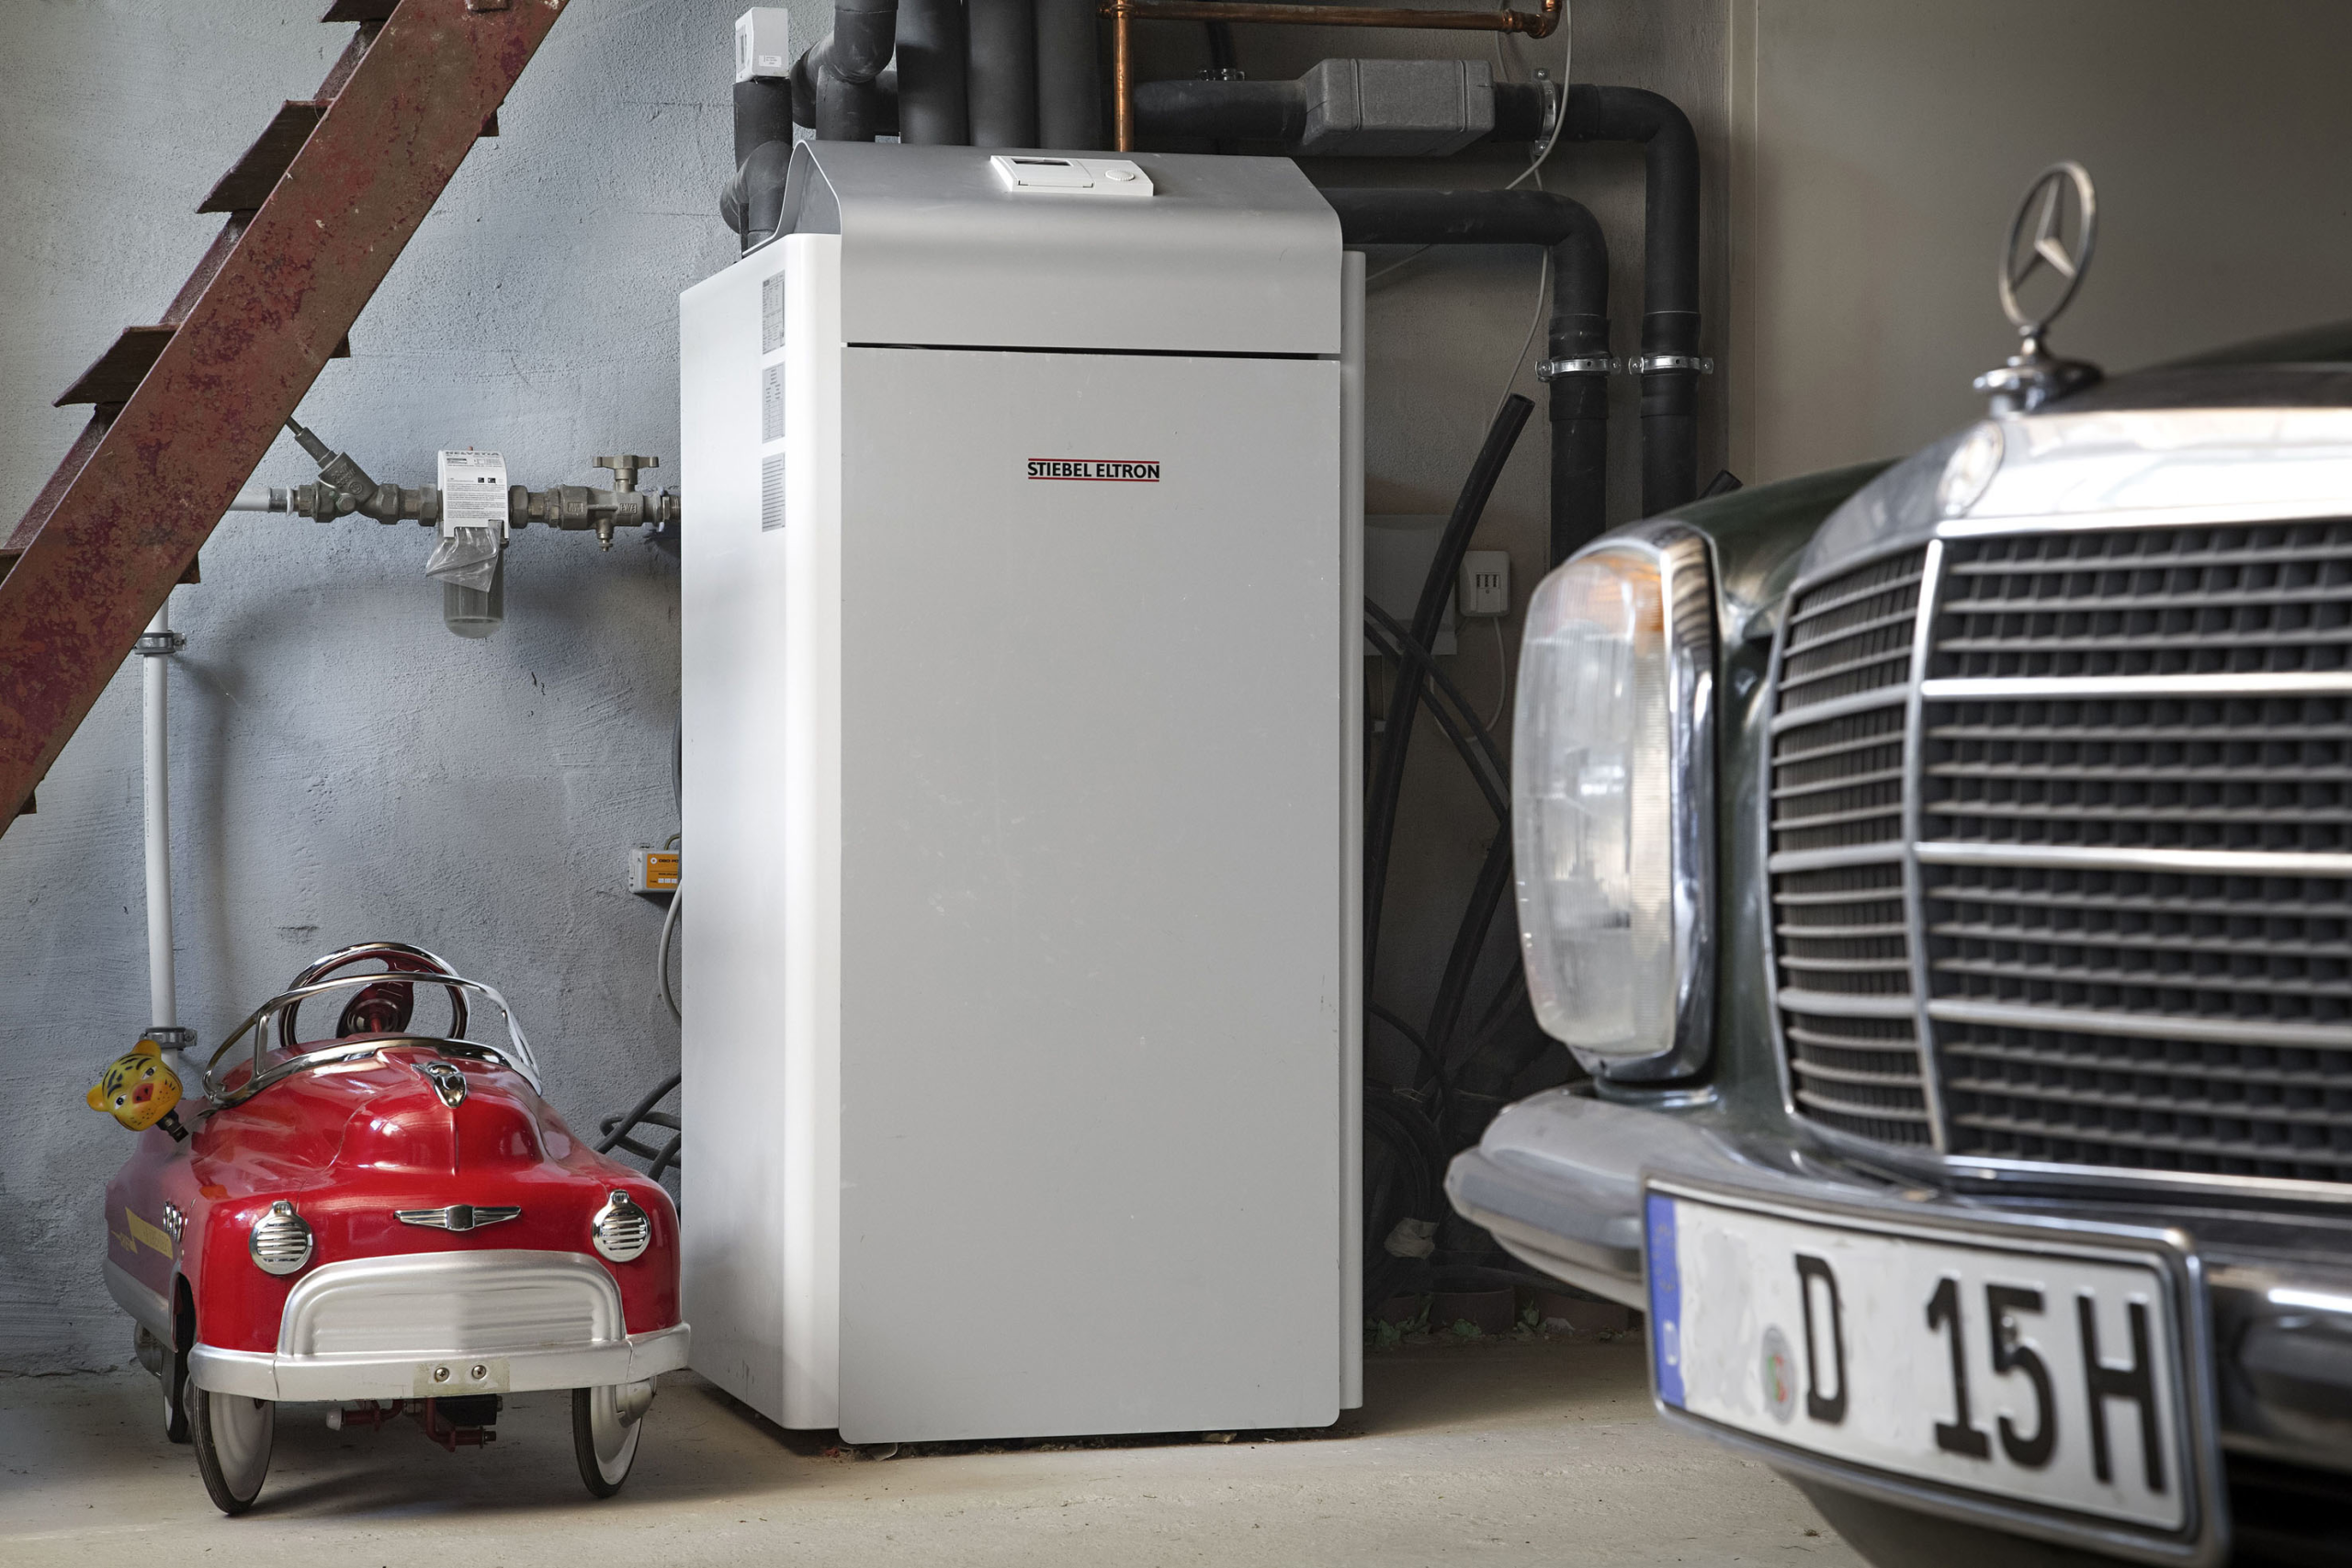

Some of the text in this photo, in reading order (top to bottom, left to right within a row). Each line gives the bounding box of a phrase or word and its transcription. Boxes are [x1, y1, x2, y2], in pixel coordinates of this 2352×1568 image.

[1027, 461, 1160, 479] STIEBEL ELTRON
[1794, 1252, 2166, 1495] D 15H
